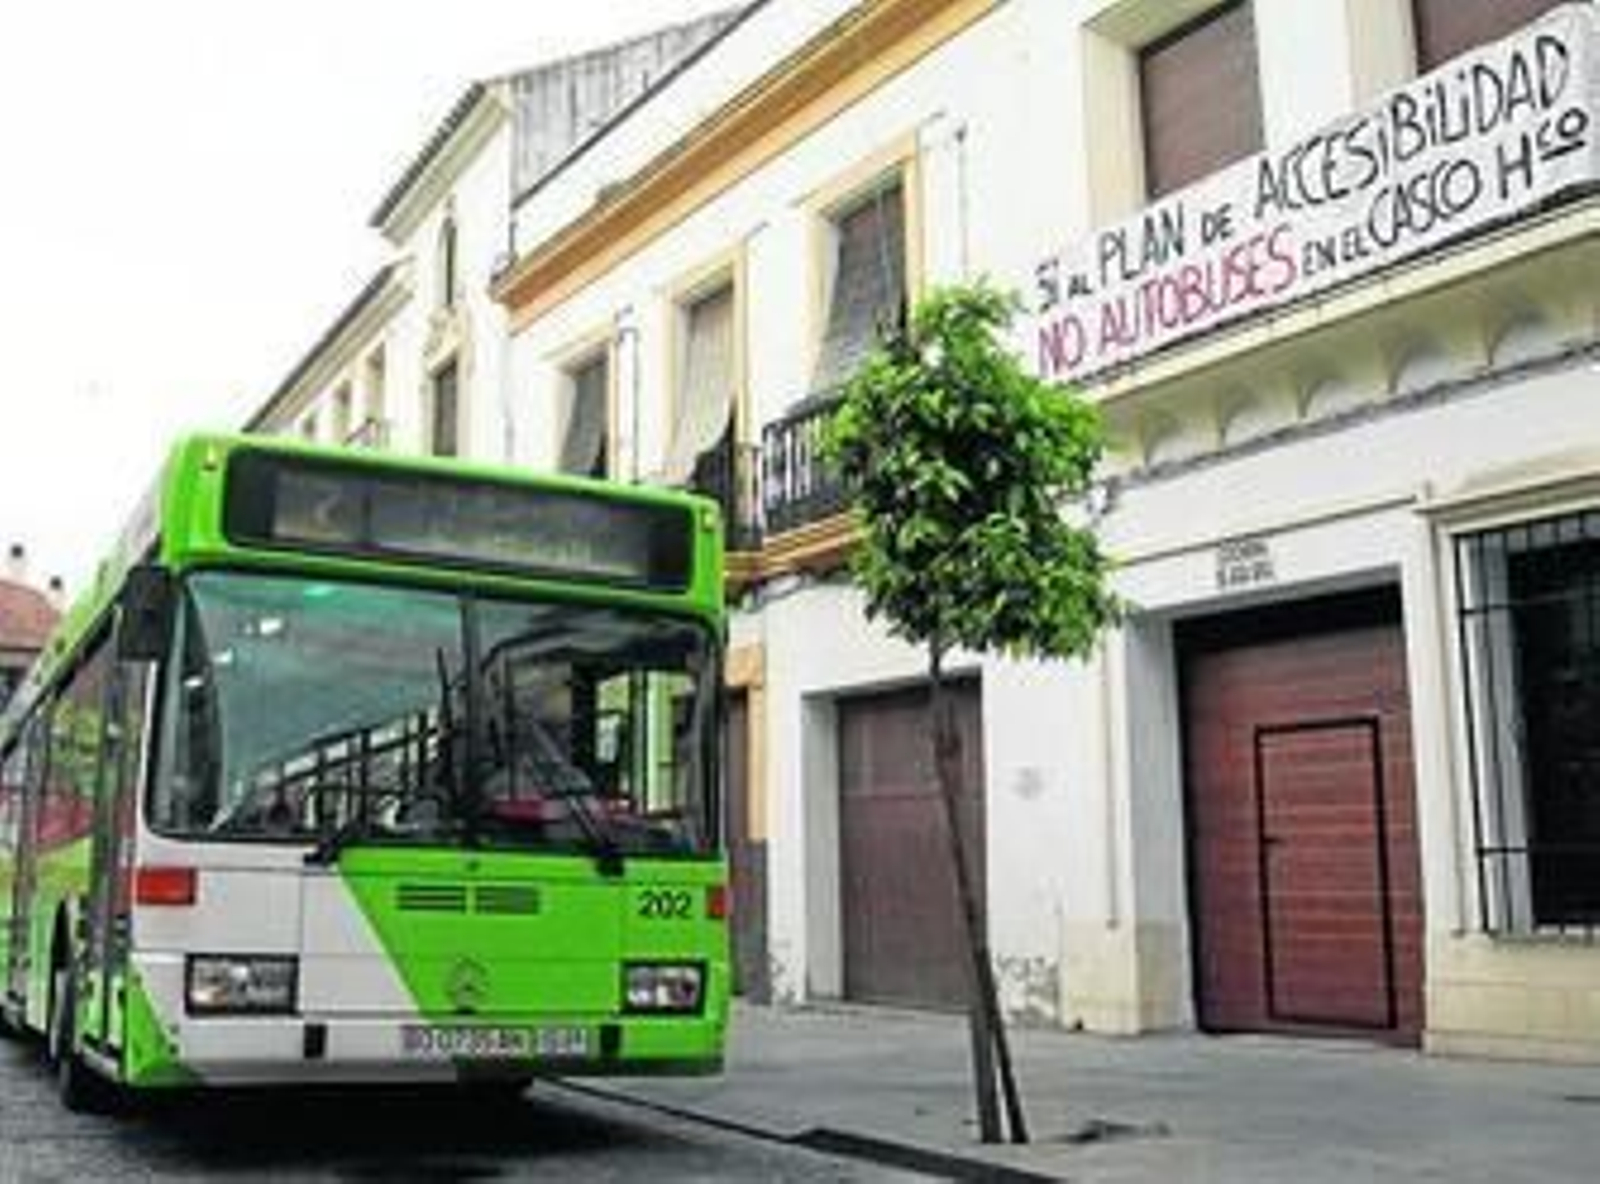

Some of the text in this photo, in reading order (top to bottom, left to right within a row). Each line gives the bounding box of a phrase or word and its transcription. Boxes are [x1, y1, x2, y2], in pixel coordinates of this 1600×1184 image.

[1038, 314, 1084, 378] NO
[1099, 222, 1297, 355] AUTOBUSES
[1302, 236, 1337, 277] EN
[1341, 226, 1370, 262] EL
[1368, 159, 1482, 248] CASCO
[1067, 272, 1093, 300] AL
[1099, 202, 1184, 288] PLAN
[1201, 203, 1232, 246] DE
[638, 890, 694, 919] 202
